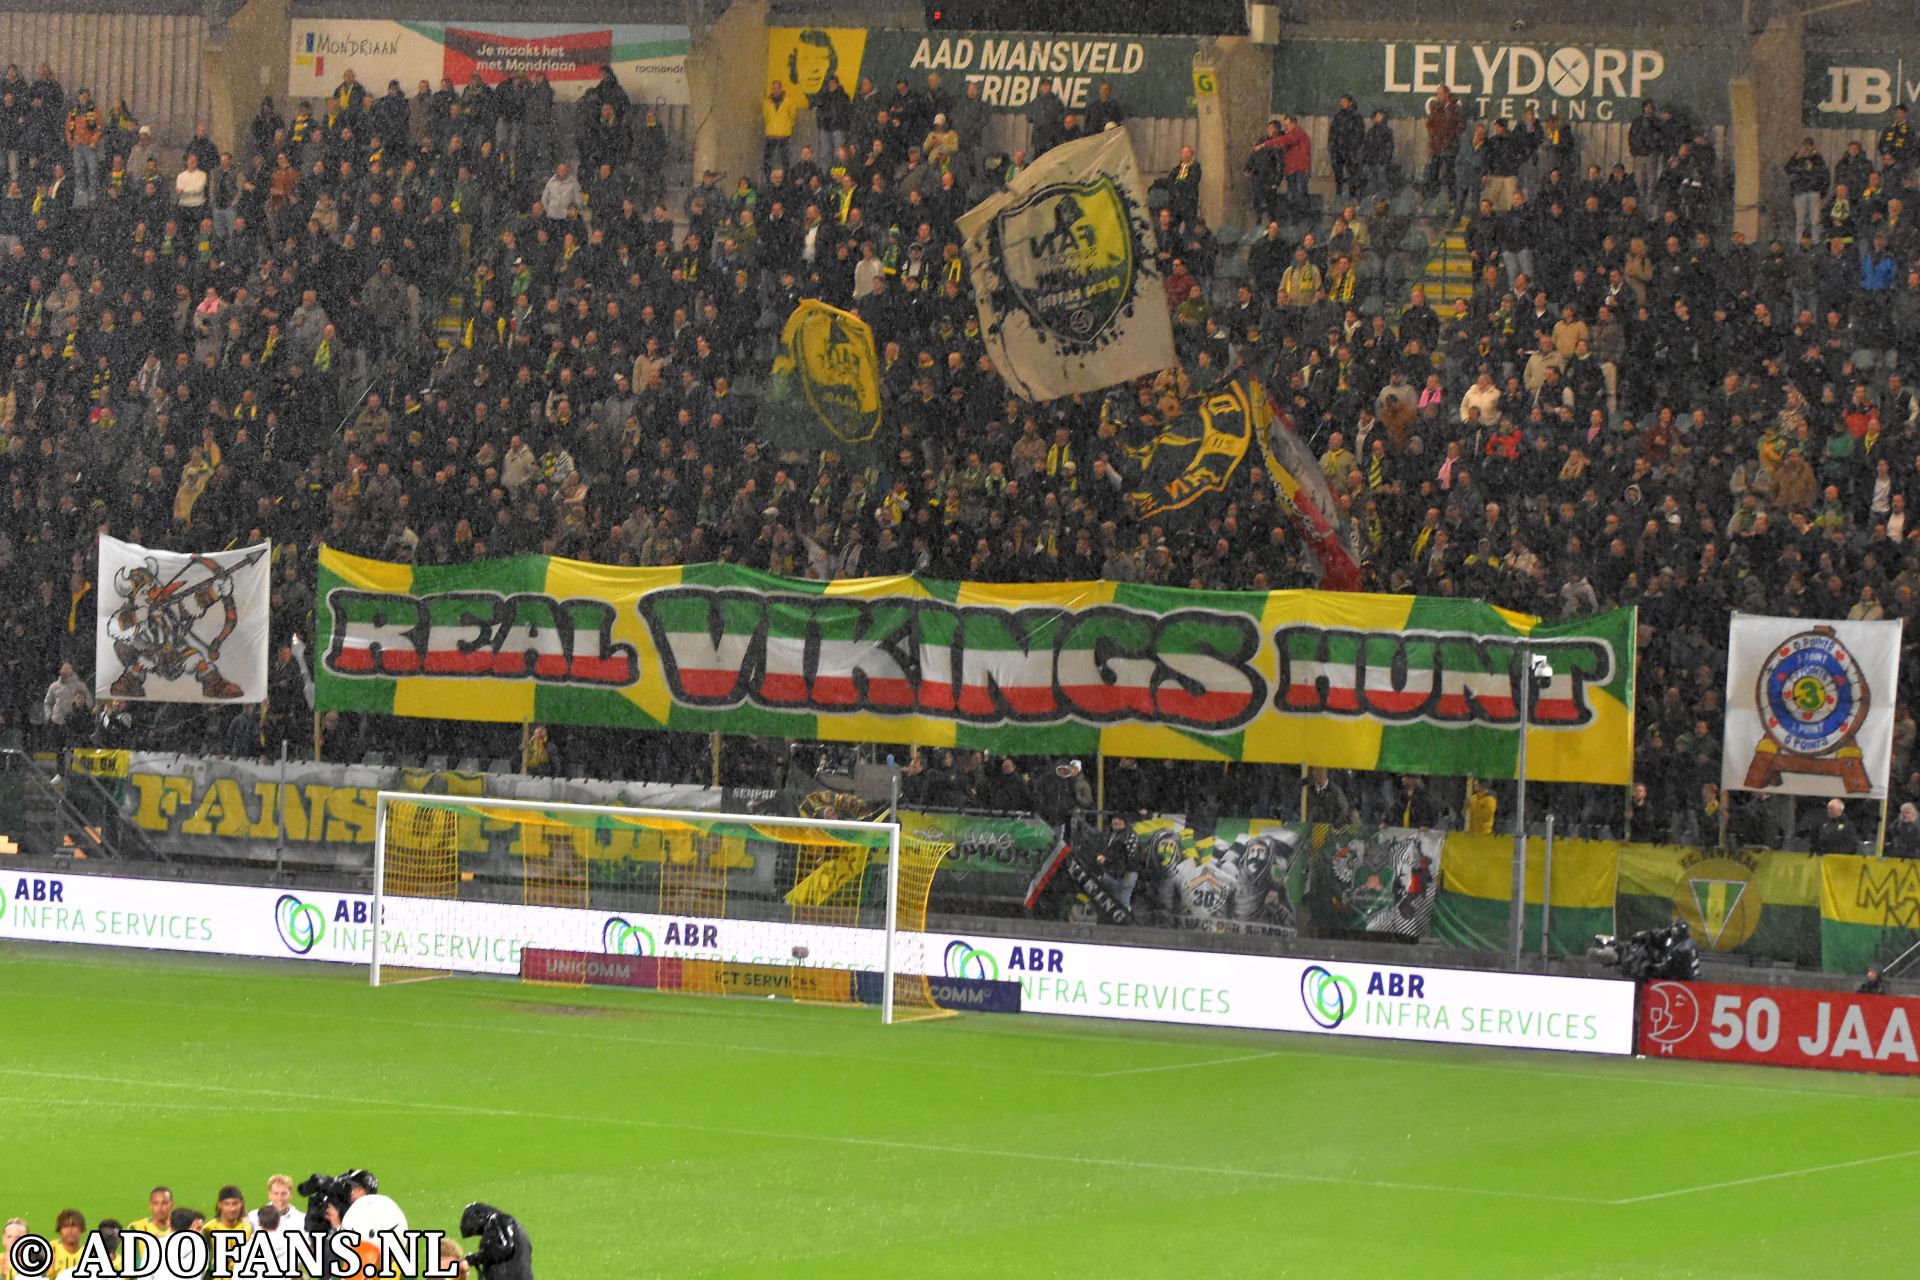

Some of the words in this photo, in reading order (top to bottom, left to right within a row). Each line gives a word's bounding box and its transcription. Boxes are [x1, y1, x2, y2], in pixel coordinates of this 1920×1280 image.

[316, 32, 401, 57] MONDRIAAN
[477, 45, 494, 56] Je
[497, 44, 540, 56] maakt
[542, 45, 565, 56] het
[909, 38, 974, 69] AAD
[979, 39, 1144, 74] MANSVELD
[476, 60, 501, 71] met
[506, 59, 576, 72] Mondriaan
[1384, 44, 1665, 98] LELYDORP
[1424, 96, 1614, 121] CTERING
[323, 587, 640, 688] REAL
[638, 584, 1274, 735] VIKINGS
[1276, 627, 1614, 730] HUNT
[1800, 681, 1820, 709] 3
[131, 773, 386, 843] FANS
[15, 878, 64, 902] ABR
[14, 905, 86, 932] INFRA
[95, 910, 213, 941] SERVICES
[664, 922, 718, 949] ABR
[333, 927, 408, 955] INFRA
[1008, 946, 1064, 973] ABR
[1009, 975, 1088, 1004] NFRA
[1099, 981, 1230, 1014] SERVICES
[1367, 971, 1424, 998] ABR
[1366, 1000, 1449, 1030] INFRA
[1461, 1007, 1597, 1040] SERVICES
[1709, 994, 1780, 1053] 50
[1798, 1002, 1920, 1063] JAA
